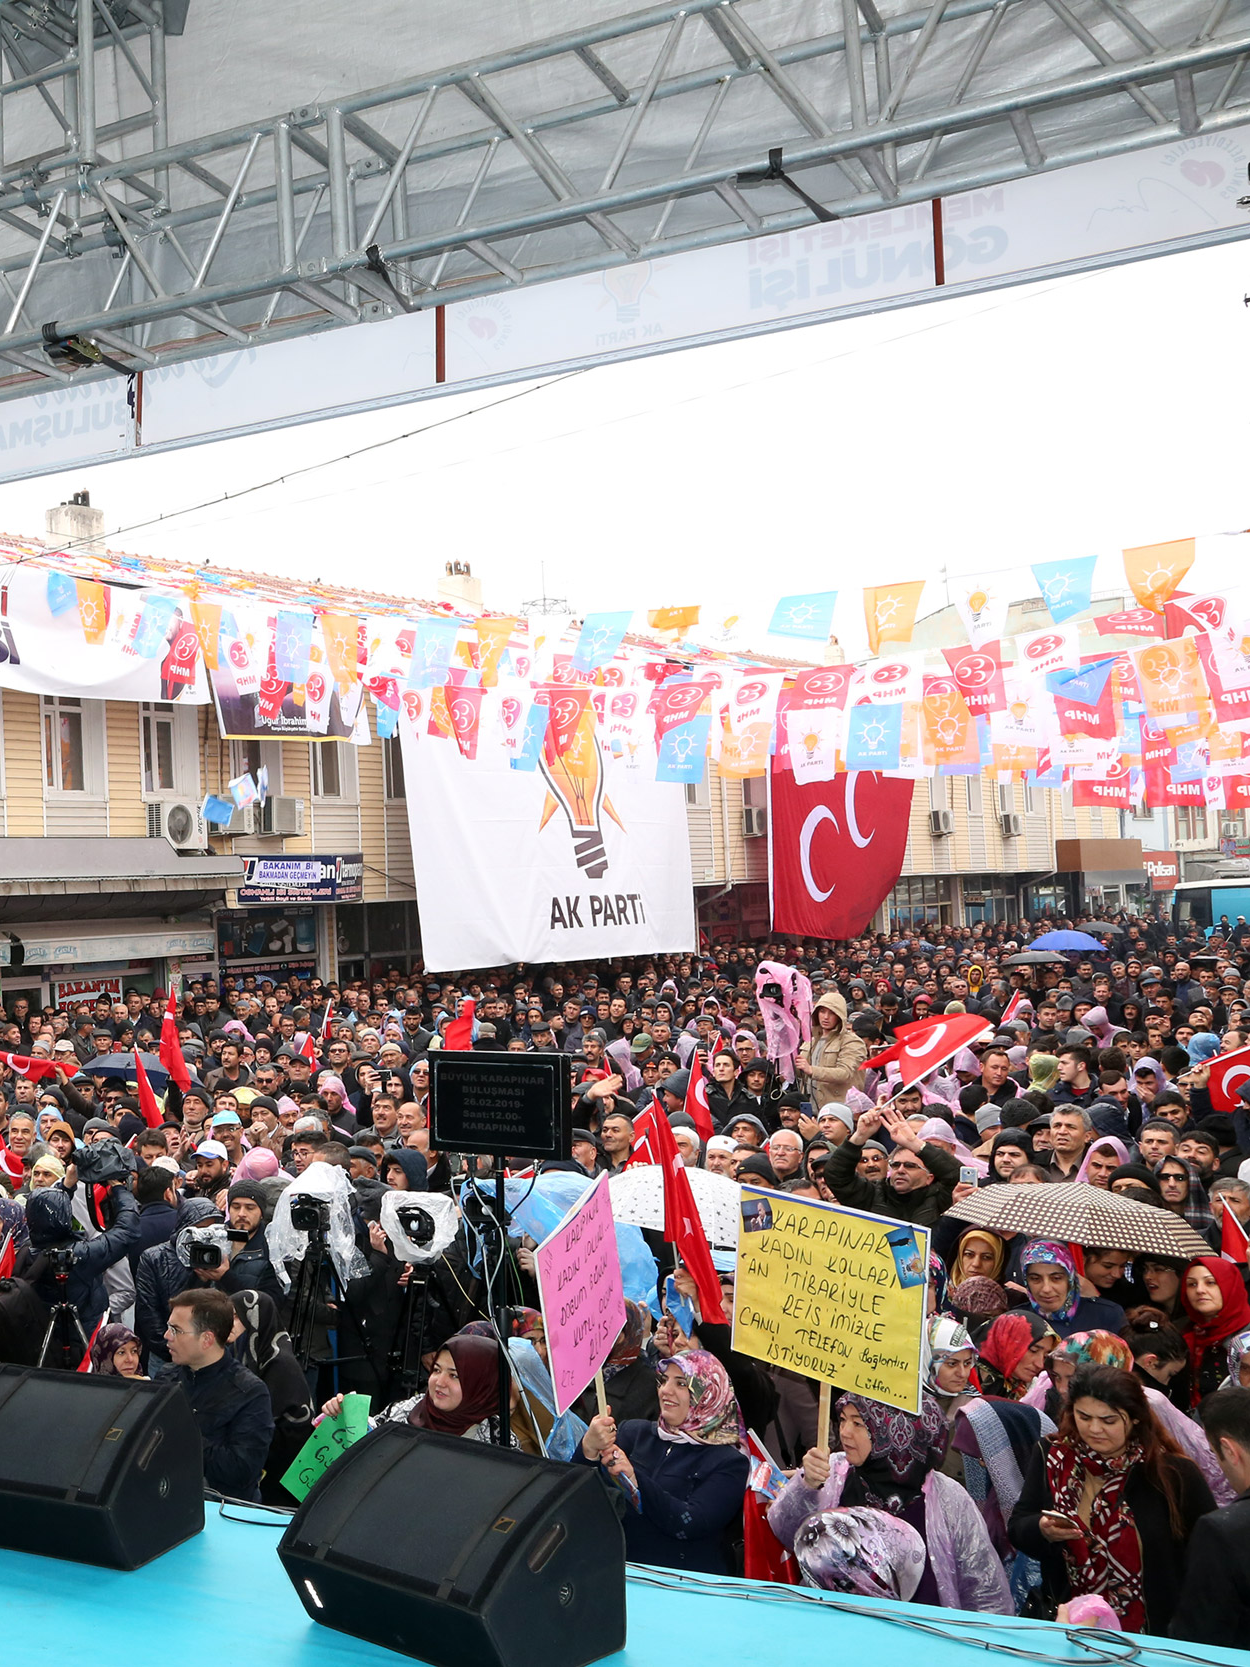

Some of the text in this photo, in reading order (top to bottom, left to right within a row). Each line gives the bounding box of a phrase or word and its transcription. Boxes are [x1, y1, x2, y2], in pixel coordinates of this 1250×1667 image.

[1145, 748, 1172, 761] MHP
[258, 871, 289, 880] BAKMADAN
[263, 862, 301, 870] BAKANIM
[550, 892, 647, 930] AK PARTİ
[440, 1071, 545, 1085] BÜYÜK KARAPINAR
[462, 1085, 525, 1096] BULUŞMASI
[462, 1121, 526, 1133] KARAPINAR
[772, 1210, 891, 1260] KARAPINAR
[557, 1256, 581, 1291] KADIN
[759, 1235, 897, 1290] KADIN KOLLARI
[784, 1263, 886, 1317] İTİBARİYLE
[739, 1306, 781, 1335] CANLI
[795, 1328, 854, 1359] TELEFON
